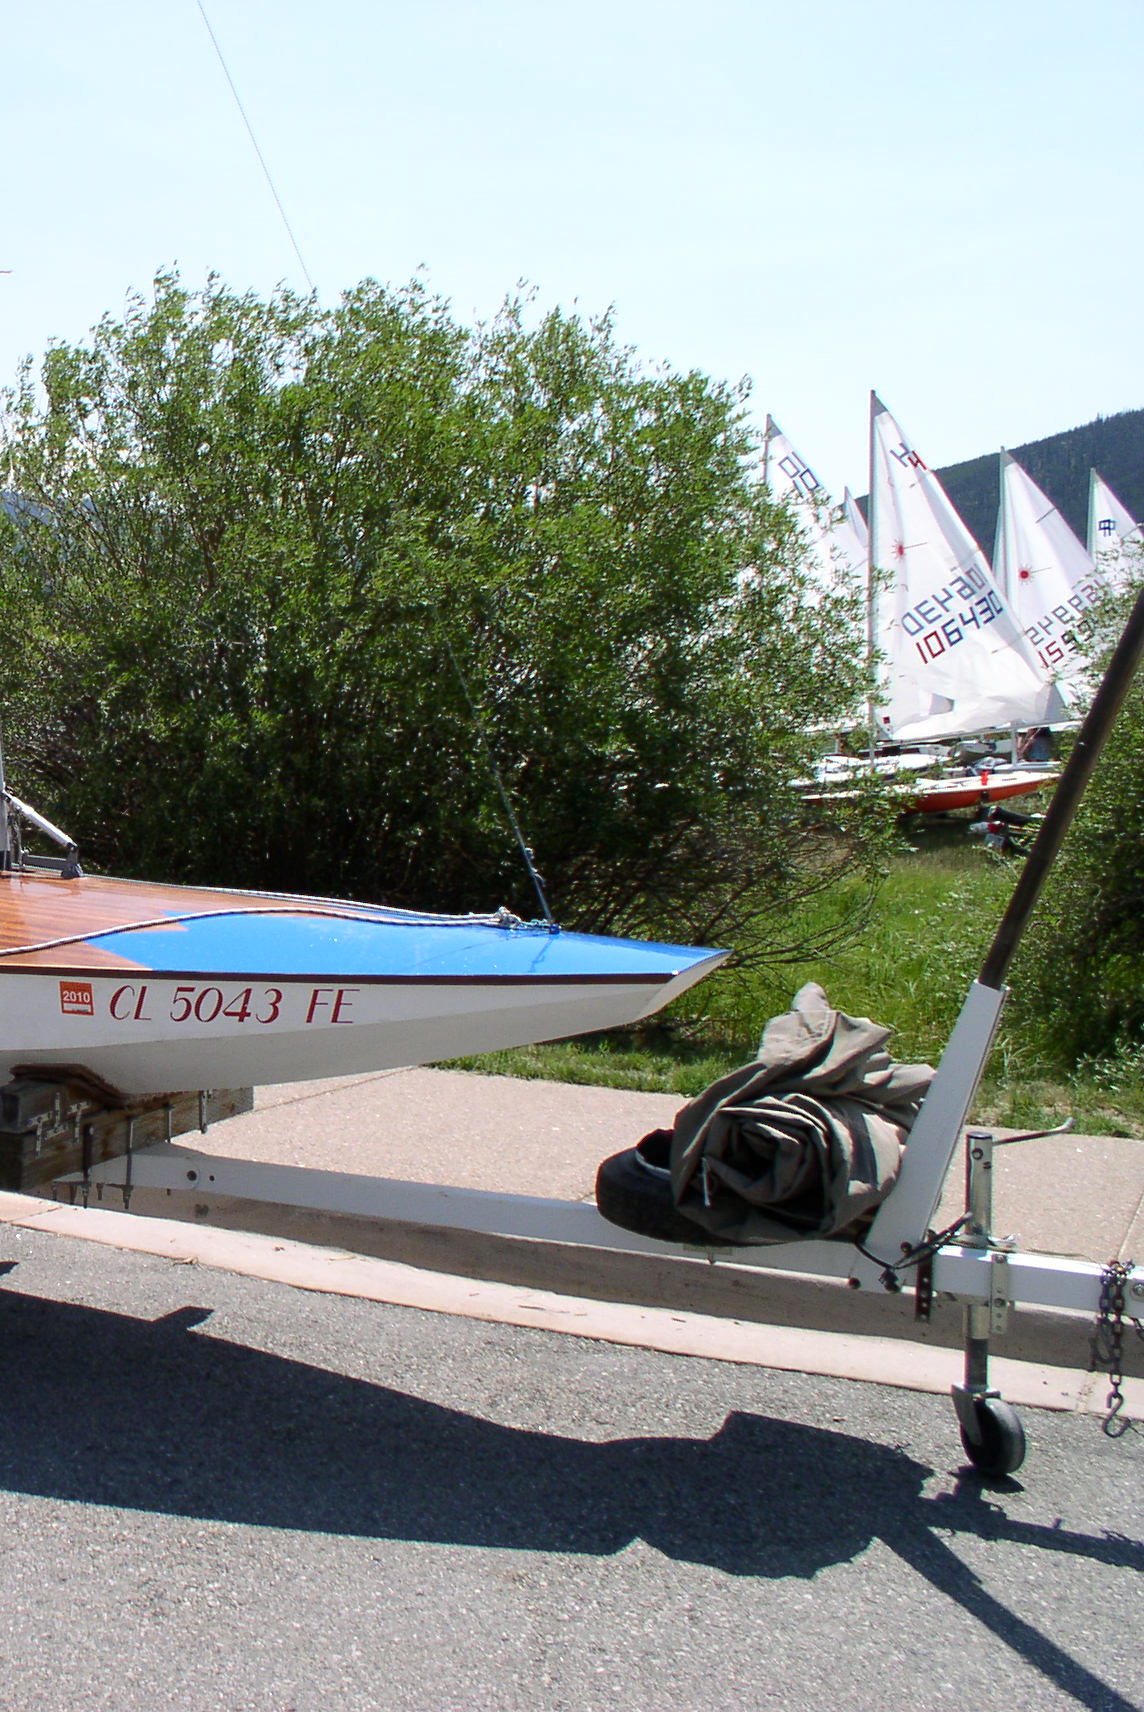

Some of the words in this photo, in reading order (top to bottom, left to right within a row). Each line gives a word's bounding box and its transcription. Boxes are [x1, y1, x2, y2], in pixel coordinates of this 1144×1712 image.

[915, 589, 1003, 664] 106430
[62, 990, 91, 1004] 2010
[109, 985, 153, 1021] CL
[169, 986, 283, 1024] 5043
[305, 988, 361, 1024] FE
